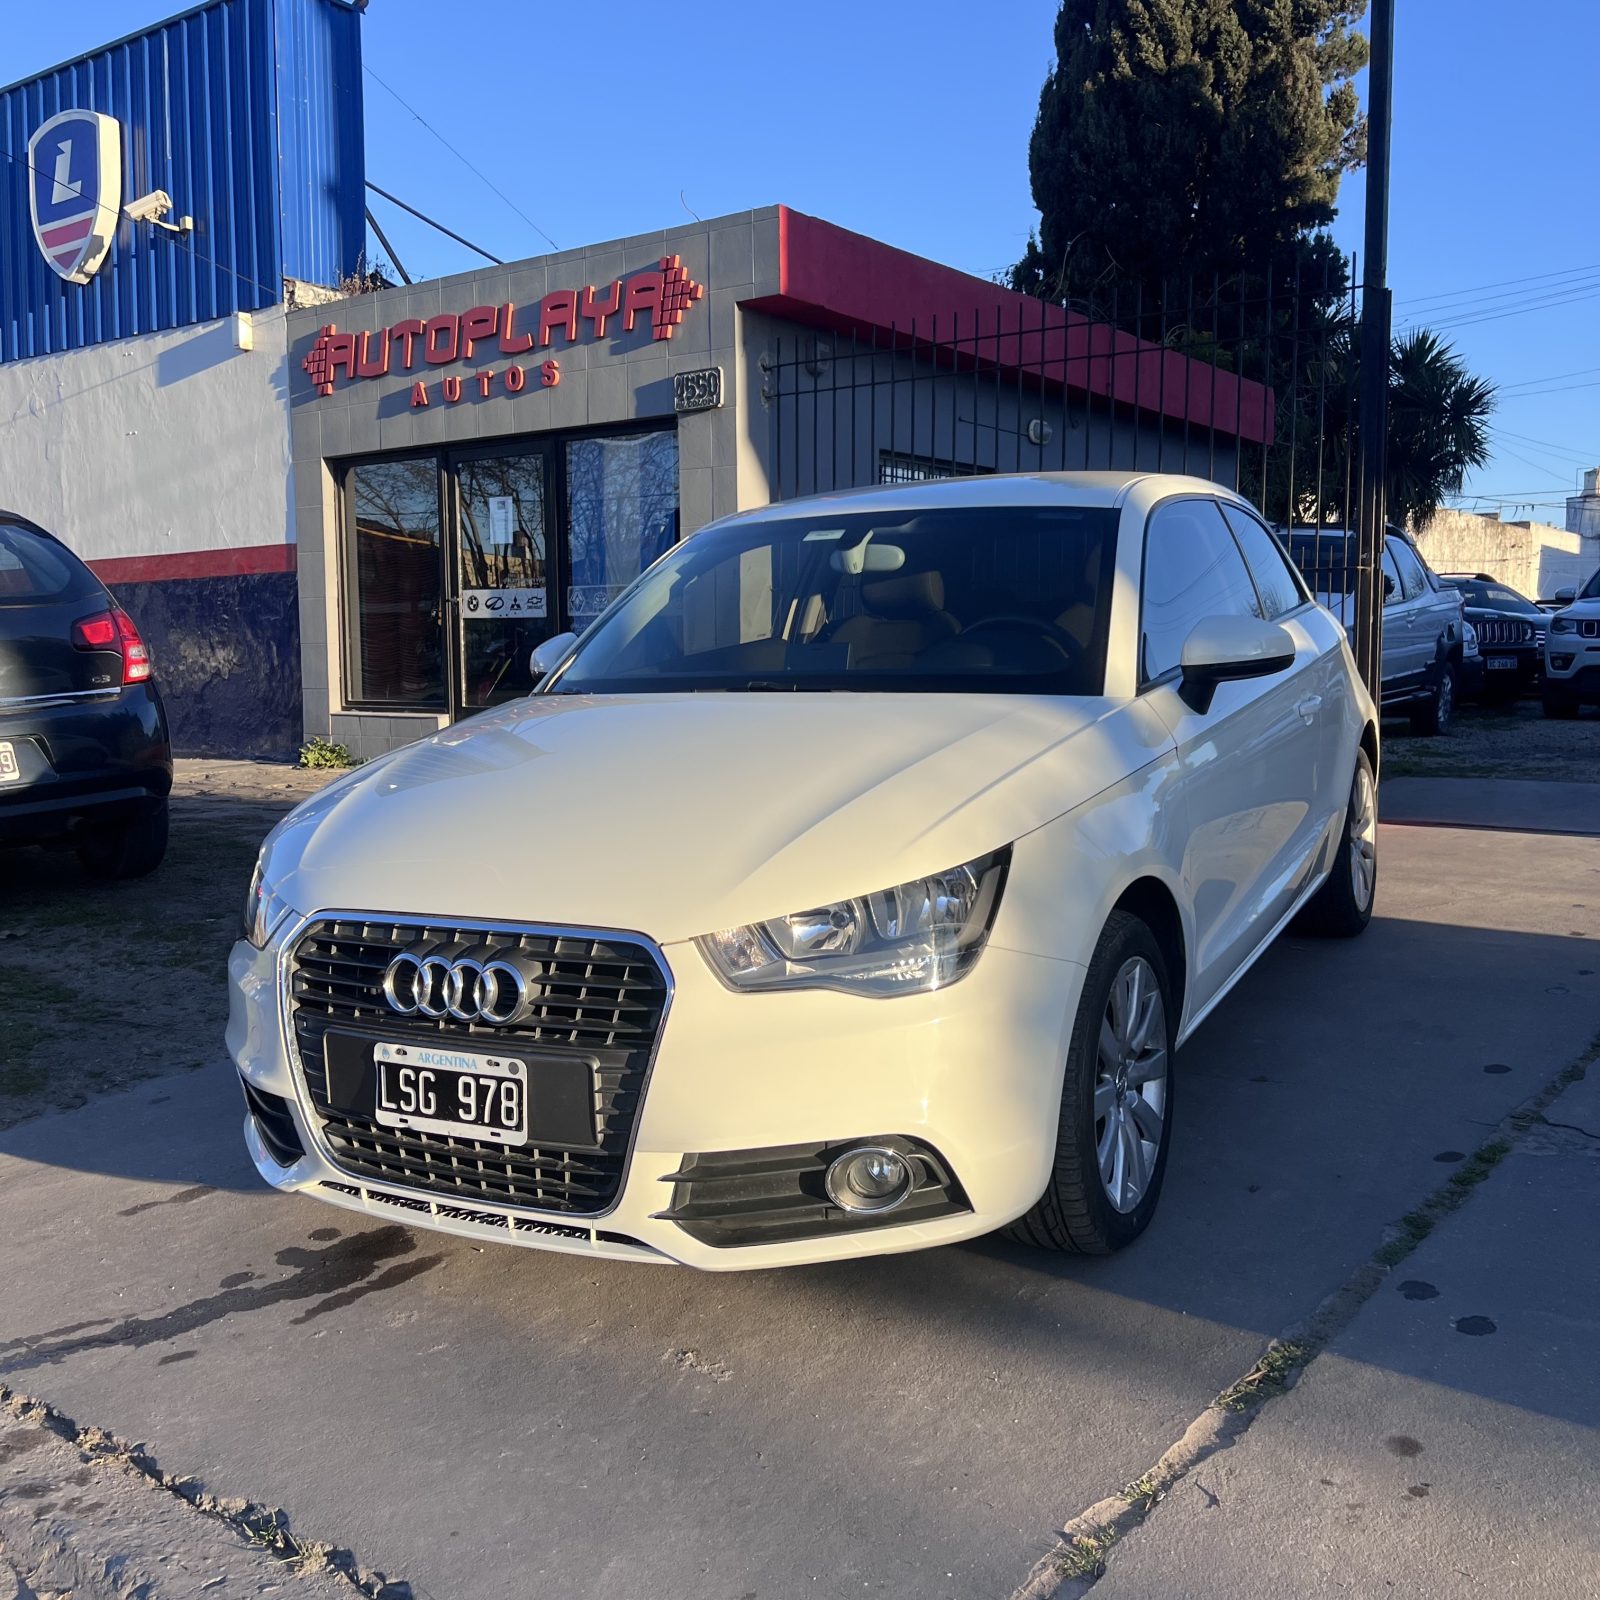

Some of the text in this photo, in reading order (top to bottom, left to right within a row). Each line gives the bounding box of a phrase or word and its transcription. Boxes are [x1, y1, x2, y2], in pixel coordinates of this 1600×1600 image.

[325, 271, 665, 382] AUTOPLAYA
[409, 359, 560, 408] AUTOS
[0, 751, 14, 773] 9
[417, 1052, 478, 1070] ARGENTINA
[381, 1064, 519, 1127] LSG 978
